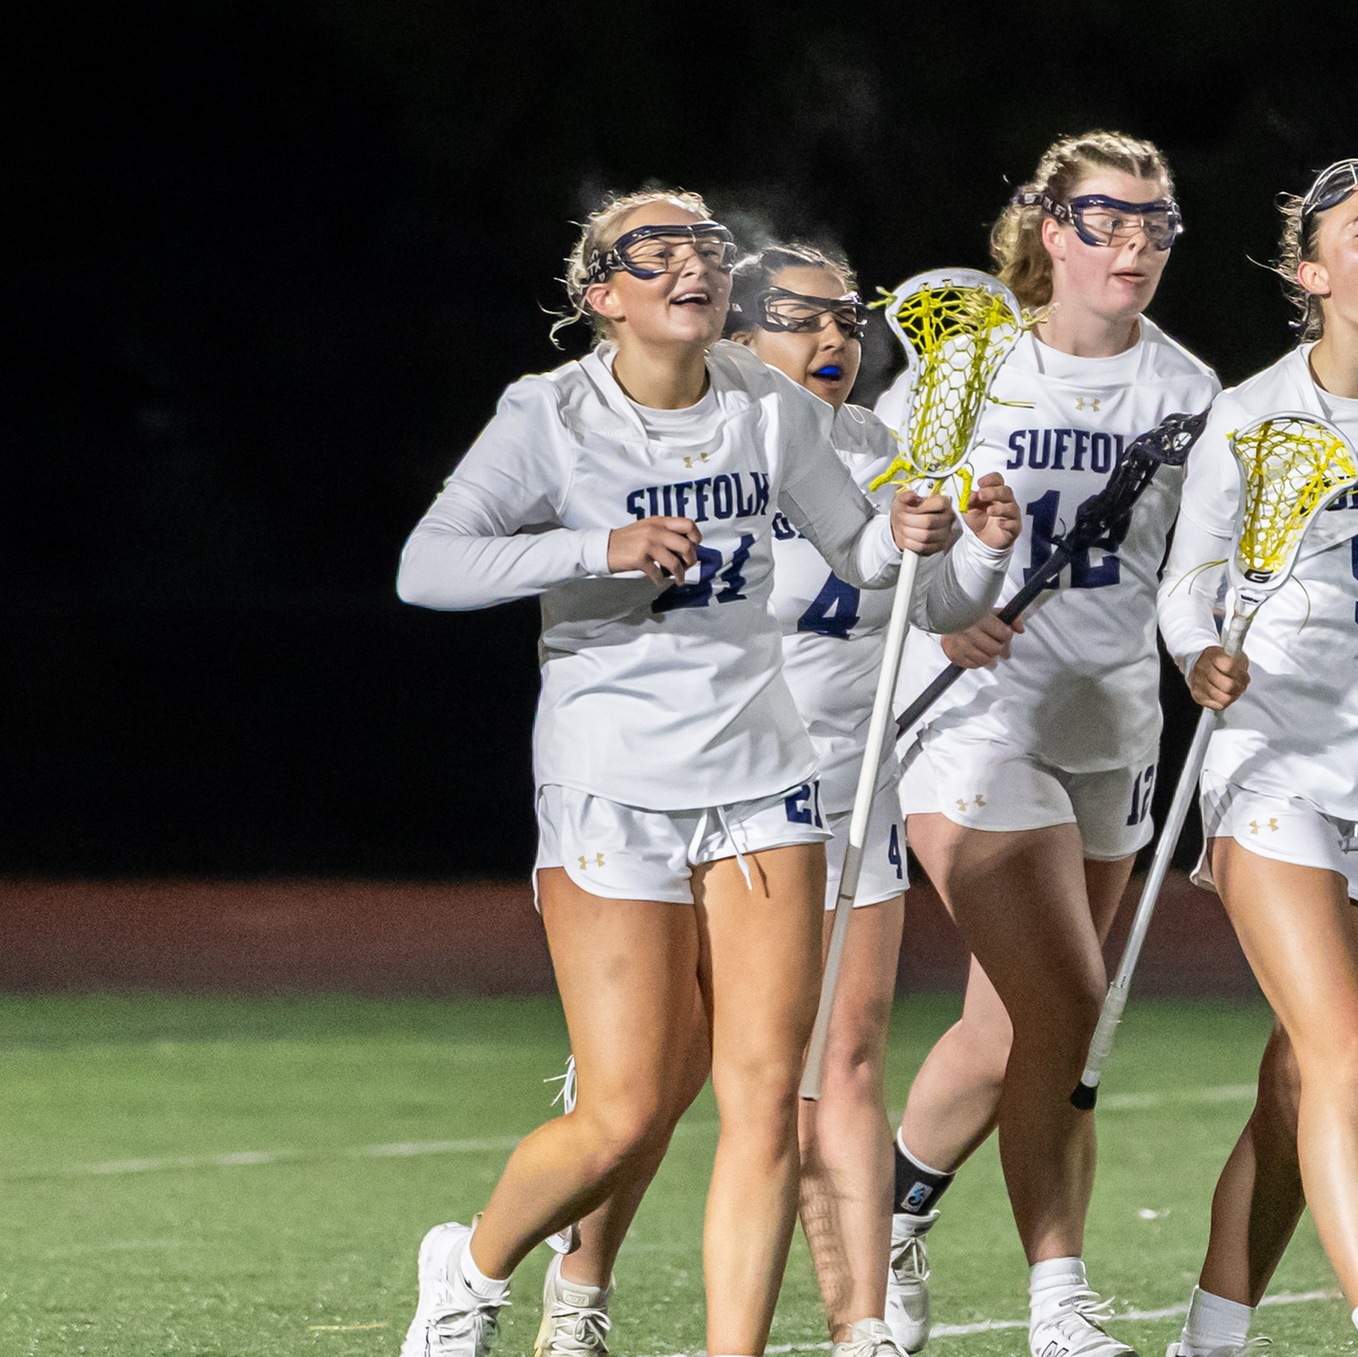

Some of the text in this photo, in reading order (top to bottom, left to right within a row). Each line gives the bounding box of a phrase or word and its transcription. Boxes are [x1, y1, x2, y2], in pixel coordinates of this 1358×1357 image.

[797, 568, 861, 640] 4
[785, 780, 824, 829] 21
[1125, 764, 1155, 826] 12
[888, 823, 904, 880] 4
